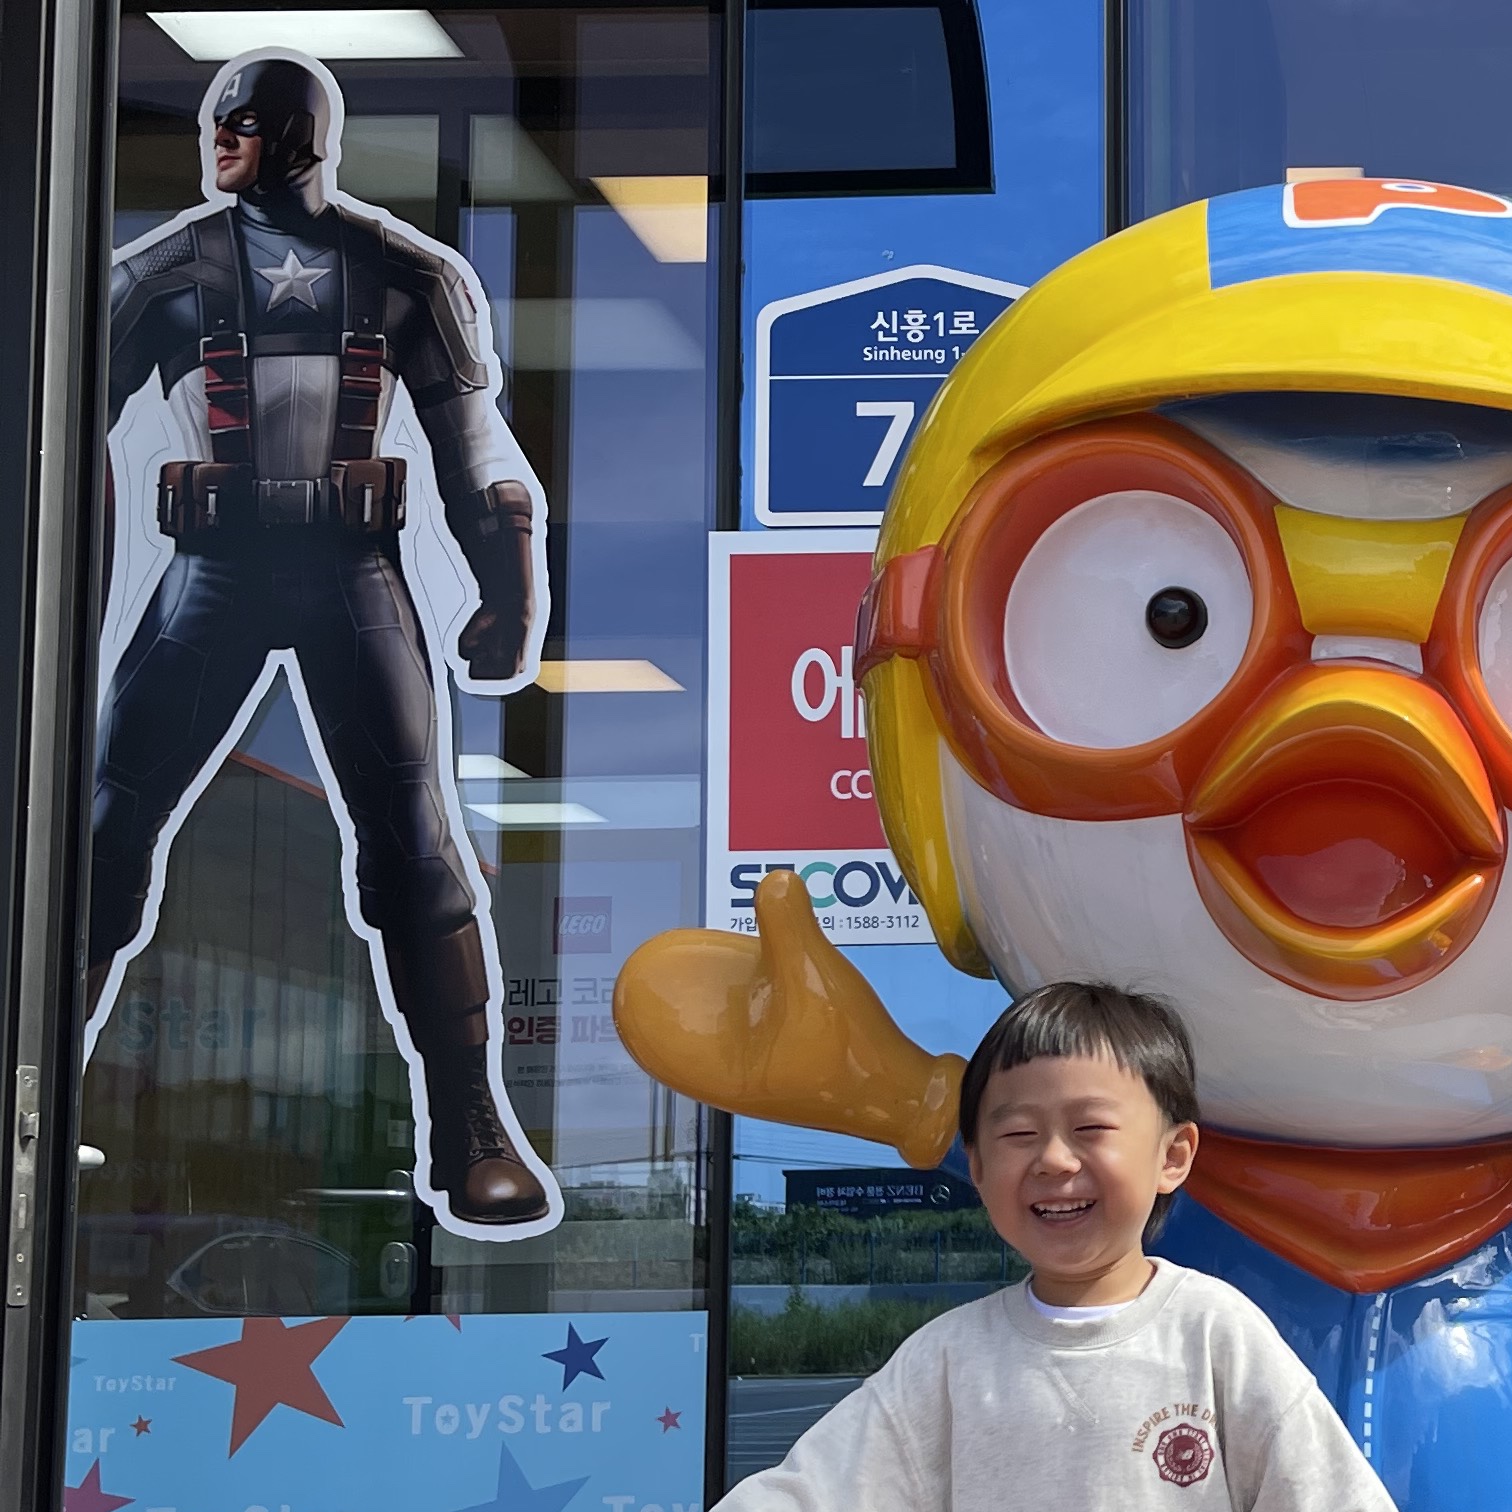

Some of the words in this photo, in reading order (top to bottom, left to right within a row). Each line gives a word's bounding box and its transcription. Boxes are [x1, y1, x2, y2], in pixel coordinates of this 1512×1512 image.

[870, 309, 980, 343] 신흥1로
[862, 346, 946, 364] Sinheung
[559, 914, 609, 936] LEGO
[508, 978, 563, 1007] 레고
[507, 1015, 561, 1045] 인증
[93, 1374, 177, 1393] ToyStar
[403, 1394, 611, 1440] ToyStar
[1131, 1406, 1171, 1453] INSPIRE
[1174, 1403, 1199, 1417] THE
